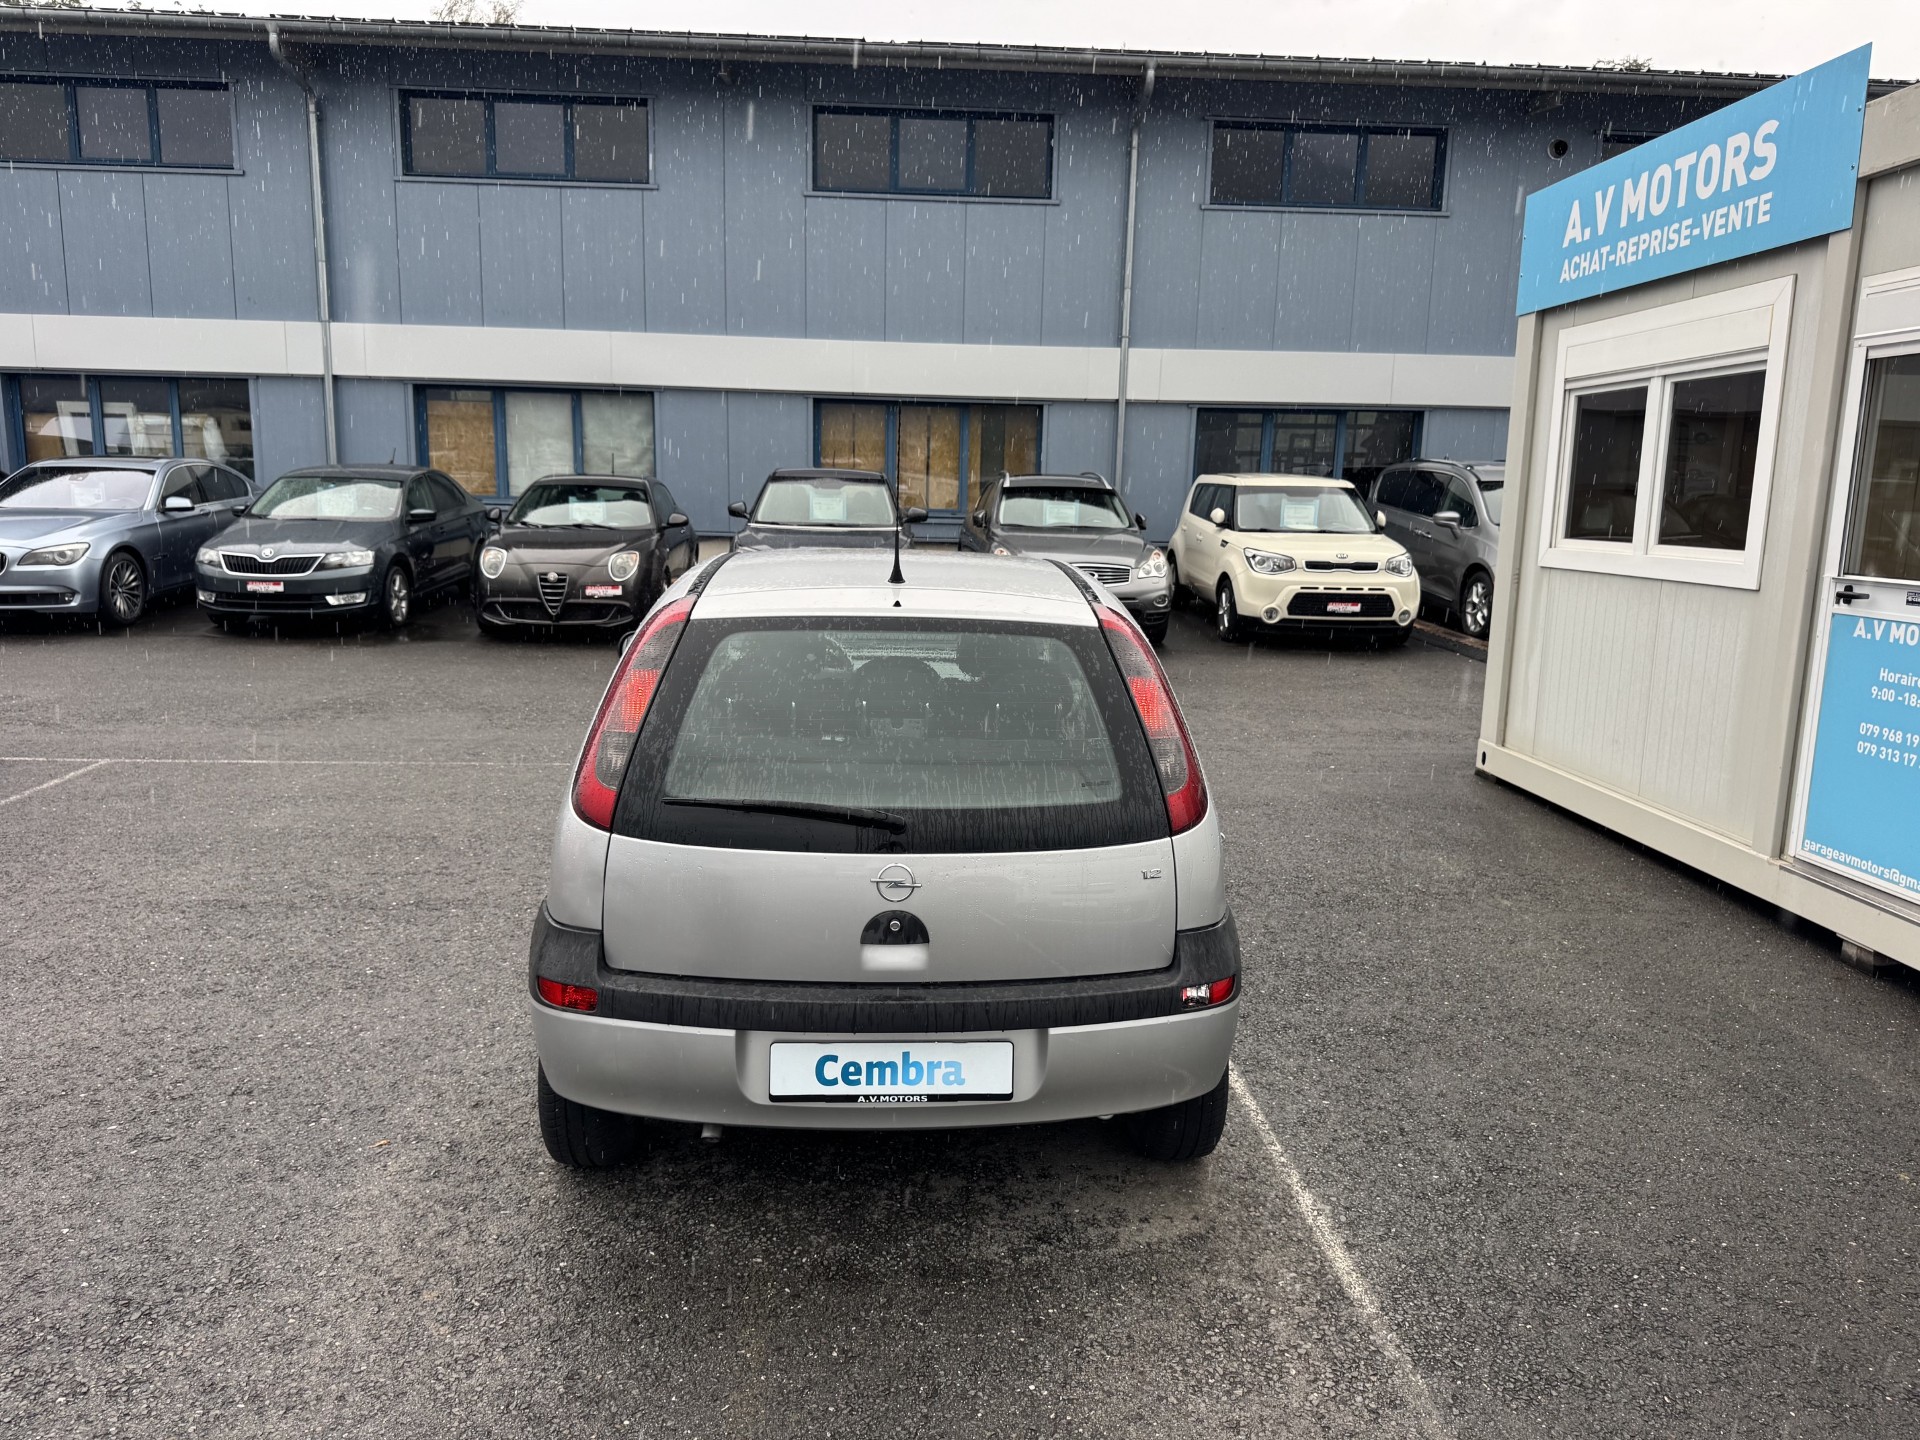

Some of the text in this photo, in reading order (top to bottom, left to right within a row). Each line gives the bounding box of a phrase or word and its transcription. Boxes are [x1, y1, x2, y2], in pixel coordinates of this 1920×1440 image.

[1562, 119, 1780, 248] A.V MOTORS
[1559, 191, 1773, 283] ACHAT-REPRISE-VENTE
[1852, 617, 1920, 646] A.V MO
[1871, 685, 1895, 702] 9:00
[1859, 722, 1920, 748] 079 968 19
[1857, 740, 1918, 767] 079 313 17
[815, 1051, 966, 1087] Cembra
[857, 1095, 928, 1103] A.V.MOTORS
